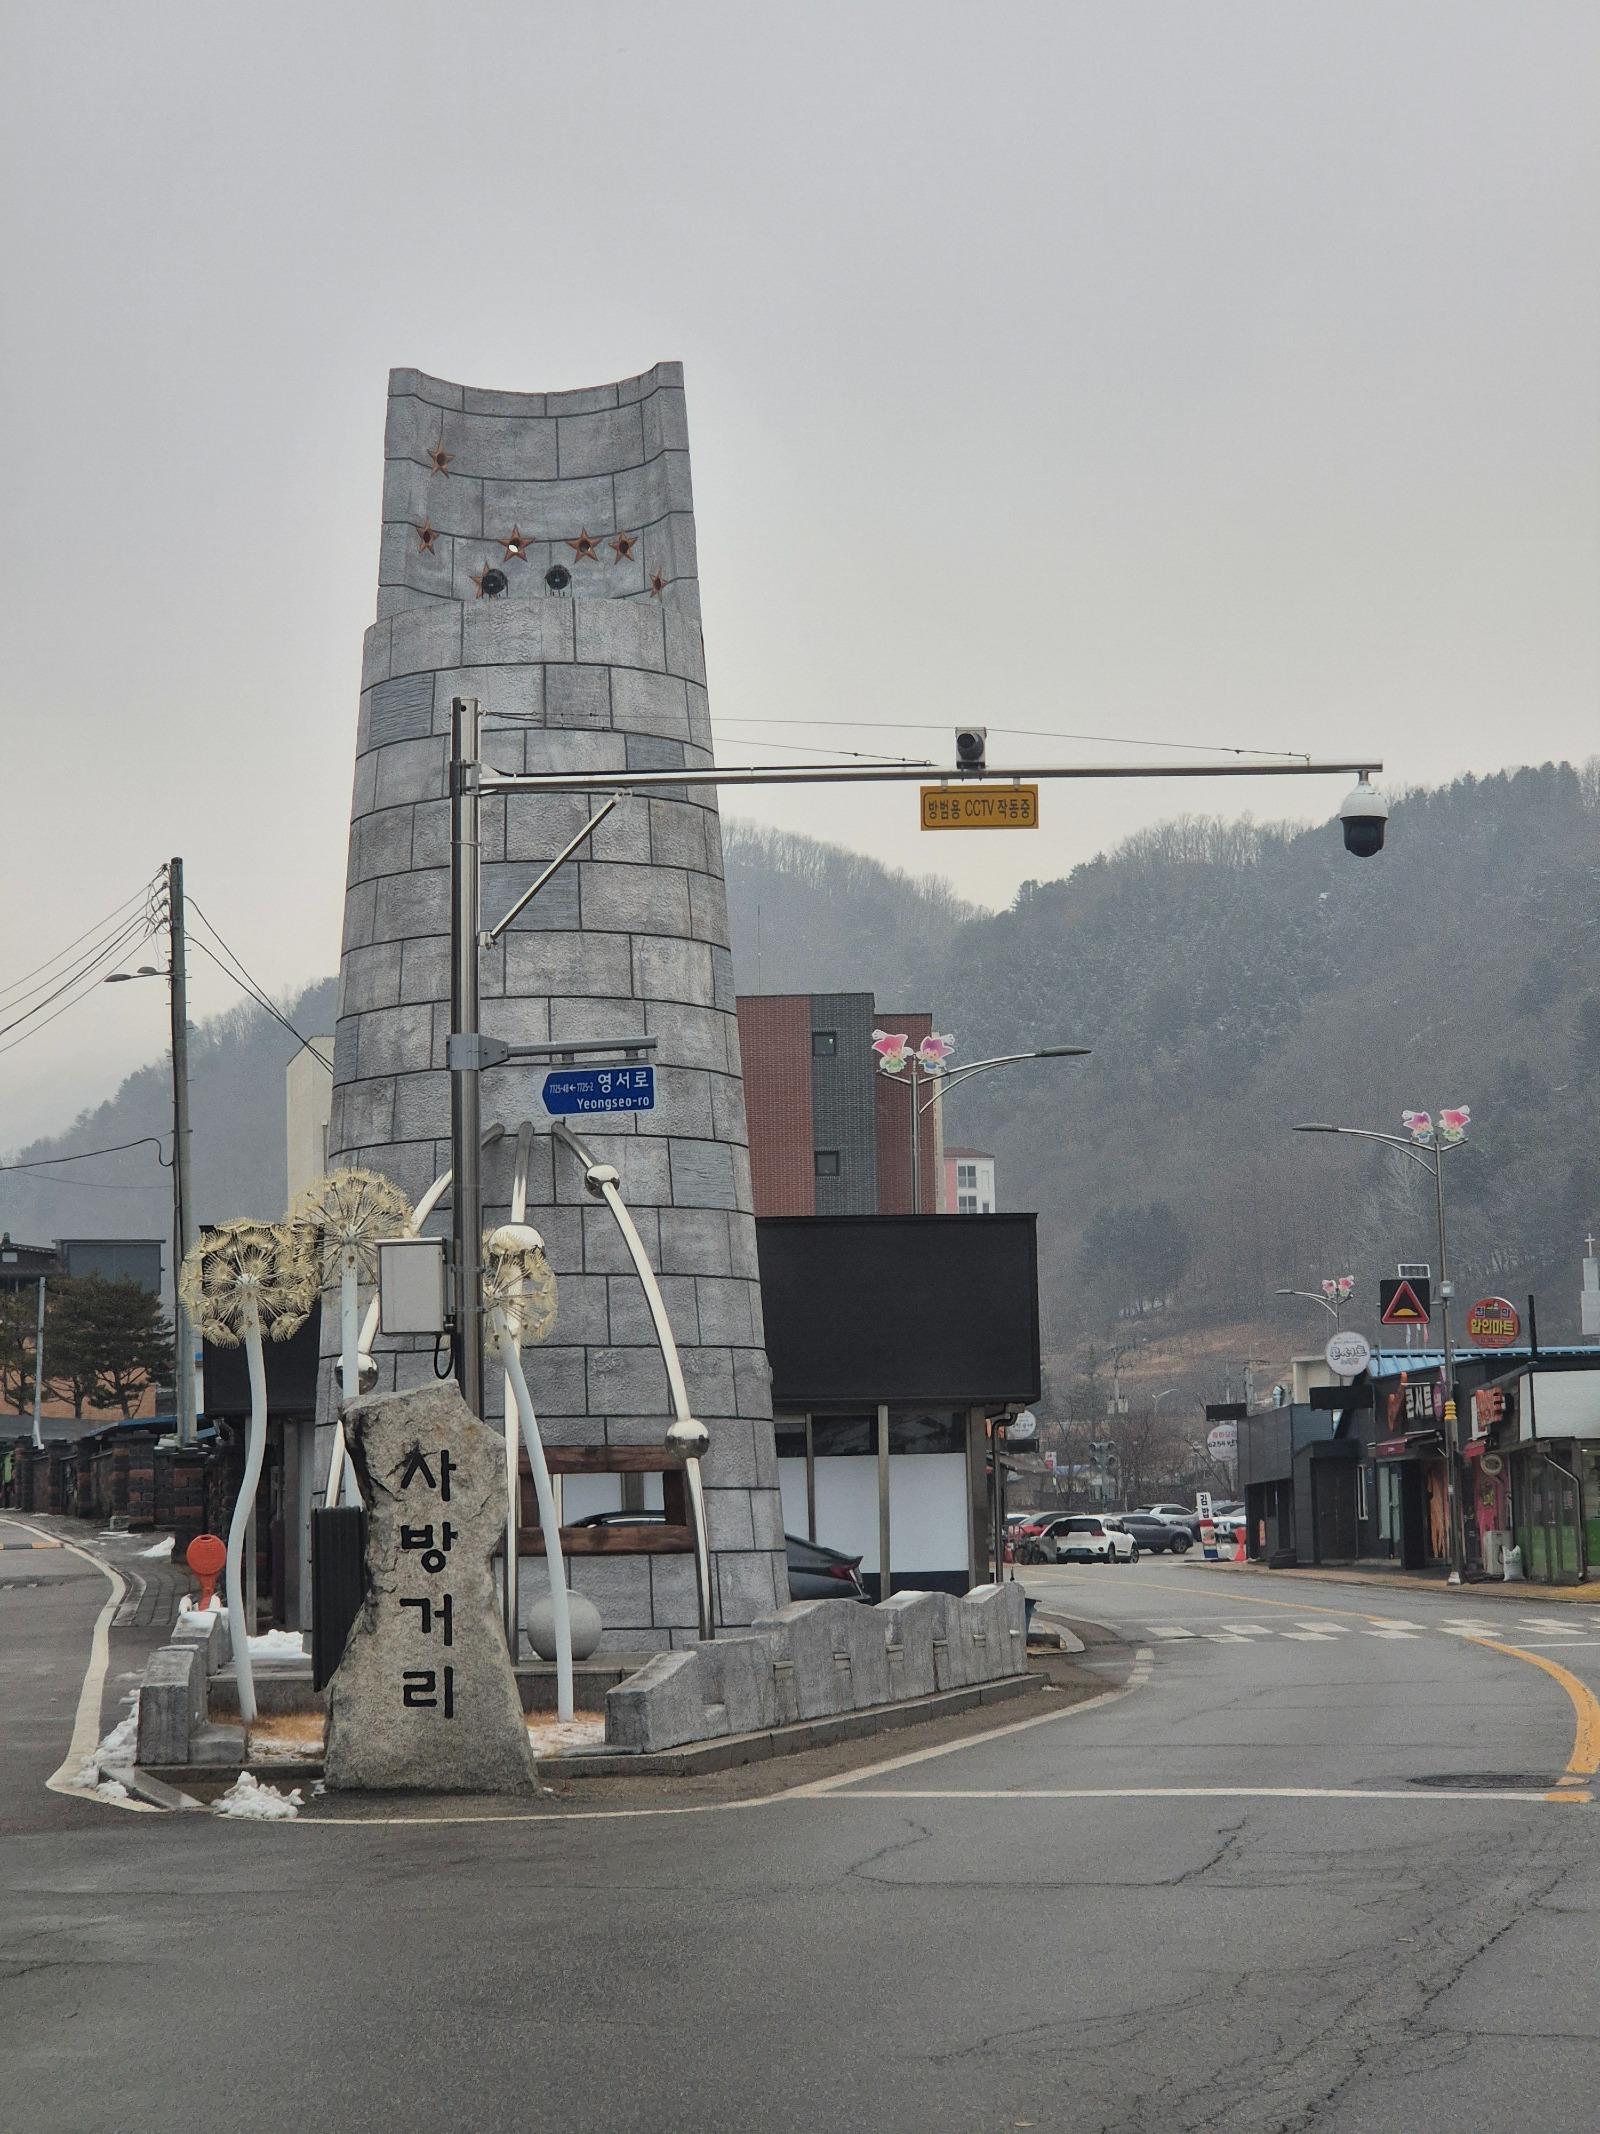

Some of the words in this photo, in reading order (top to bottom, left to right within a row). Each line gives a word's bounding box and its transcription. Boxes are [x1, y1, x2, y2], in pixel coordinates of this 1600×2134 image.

[928, 800, 961, 820] 방범용
[965, 799, 994, 817] CCTV
[997, 798, 1031, 819] 작동중
[597, 1071, 649, 1094] 영서로
[577, 1096, 650, 1111] Yeongseo-ro
[1200, 1494, 1210, 1519] 김밥
[400, 1449, 457, 1719] 사방거리
